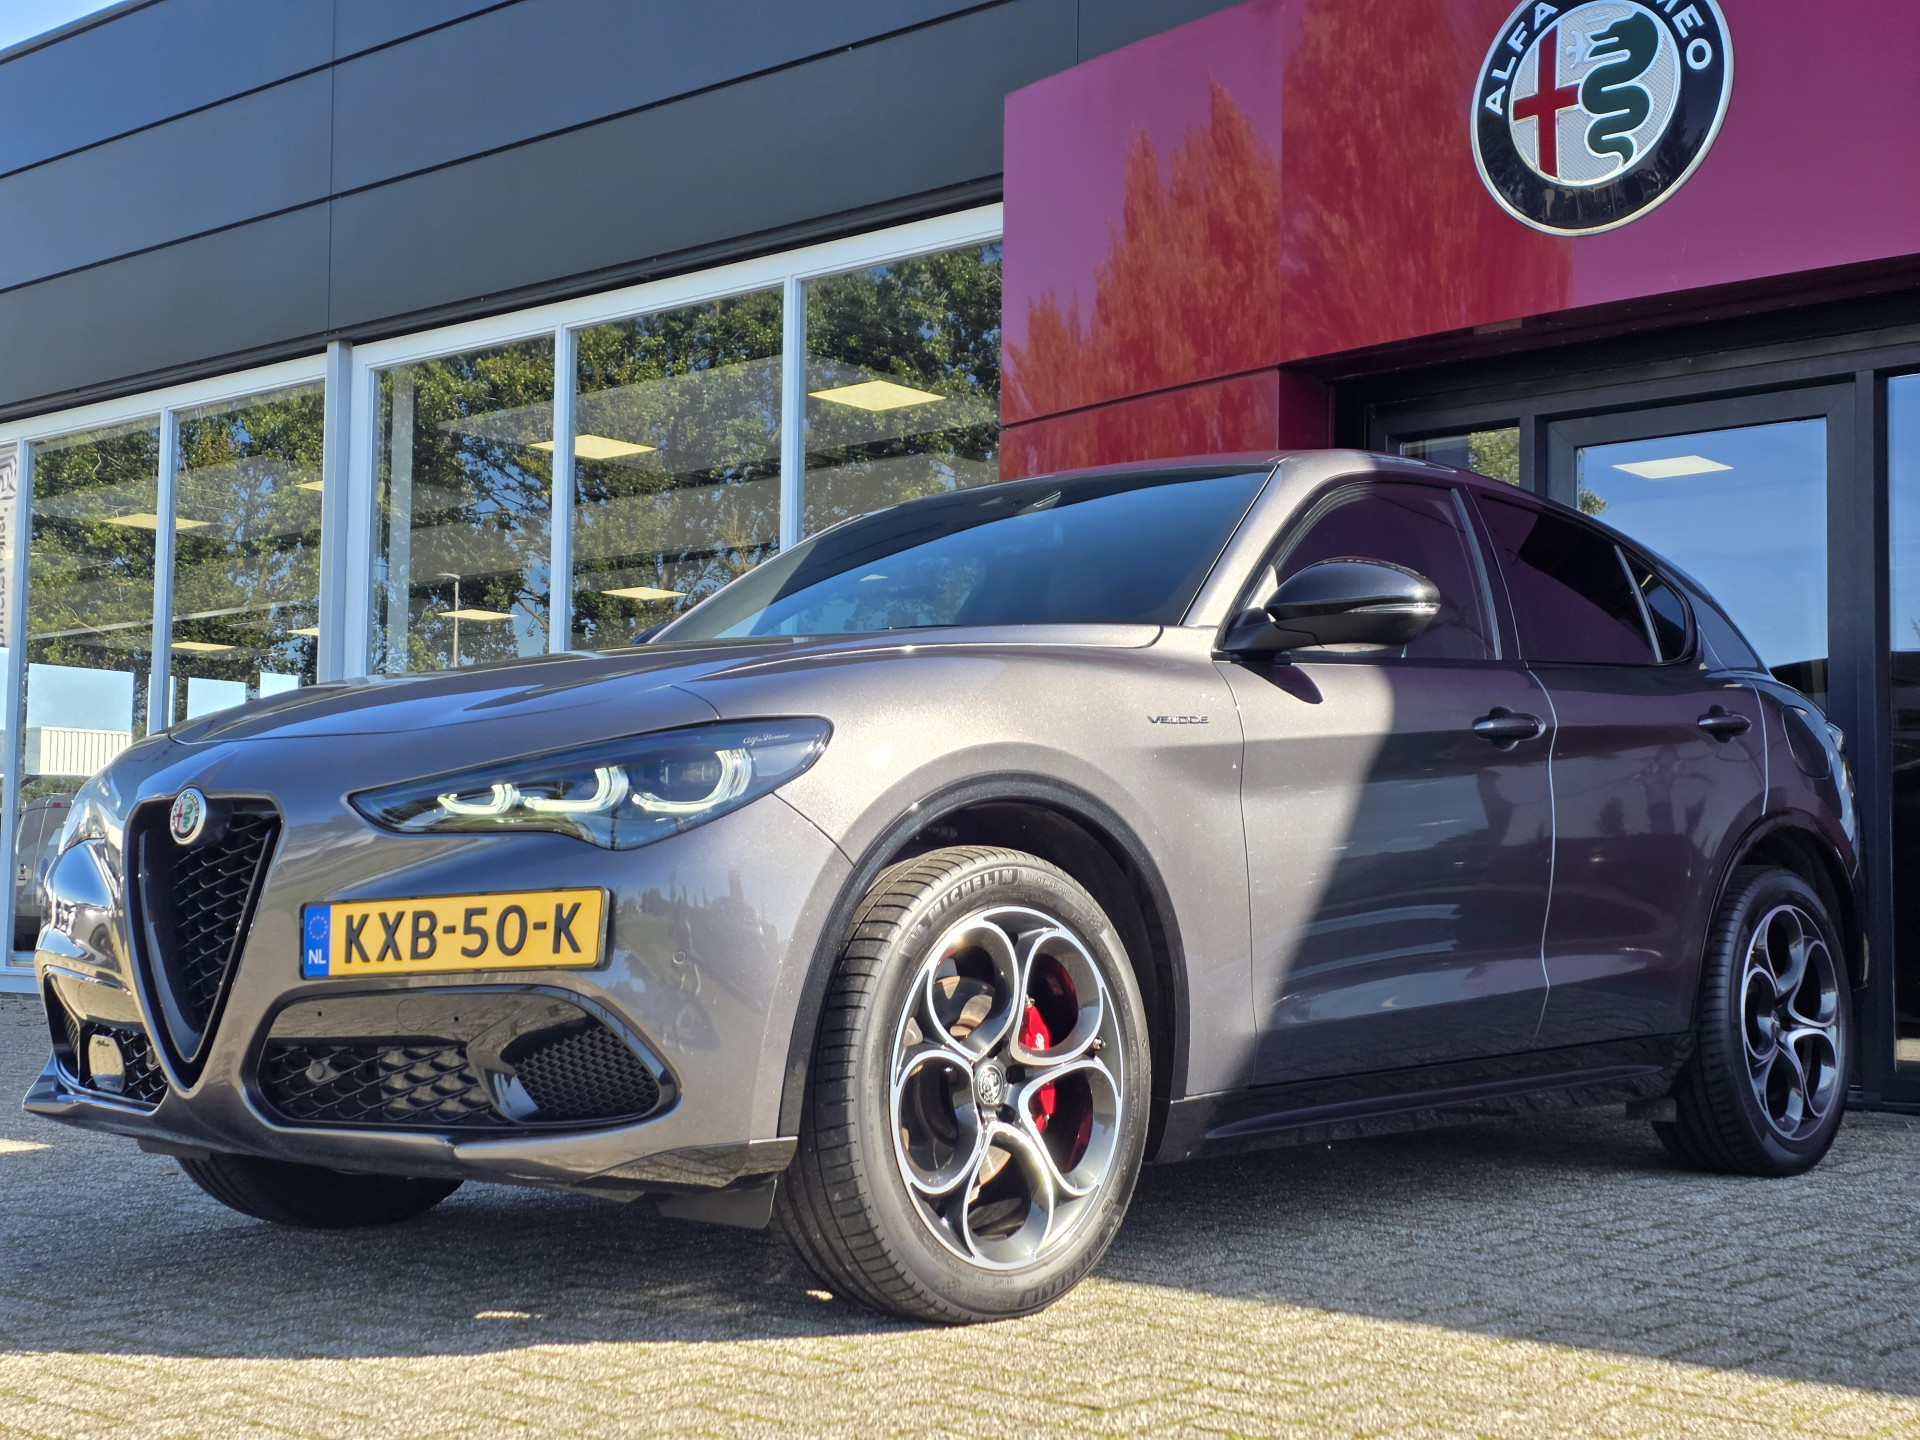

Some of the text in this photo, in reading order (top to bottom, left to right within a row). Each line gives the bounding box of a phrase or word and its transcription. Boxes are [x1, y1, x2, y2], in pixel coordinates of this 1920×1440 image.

[1485, 2, 1558, 115] ALFA
[1146, 715, 1209, 724] VELOCE
[743, 736, 762, 746] Alfa
[928, 869, 1013, 923] MICHELIN
[344, 902, 582, 964] KXB-50-K
[308, 949, 327, 964] NL
